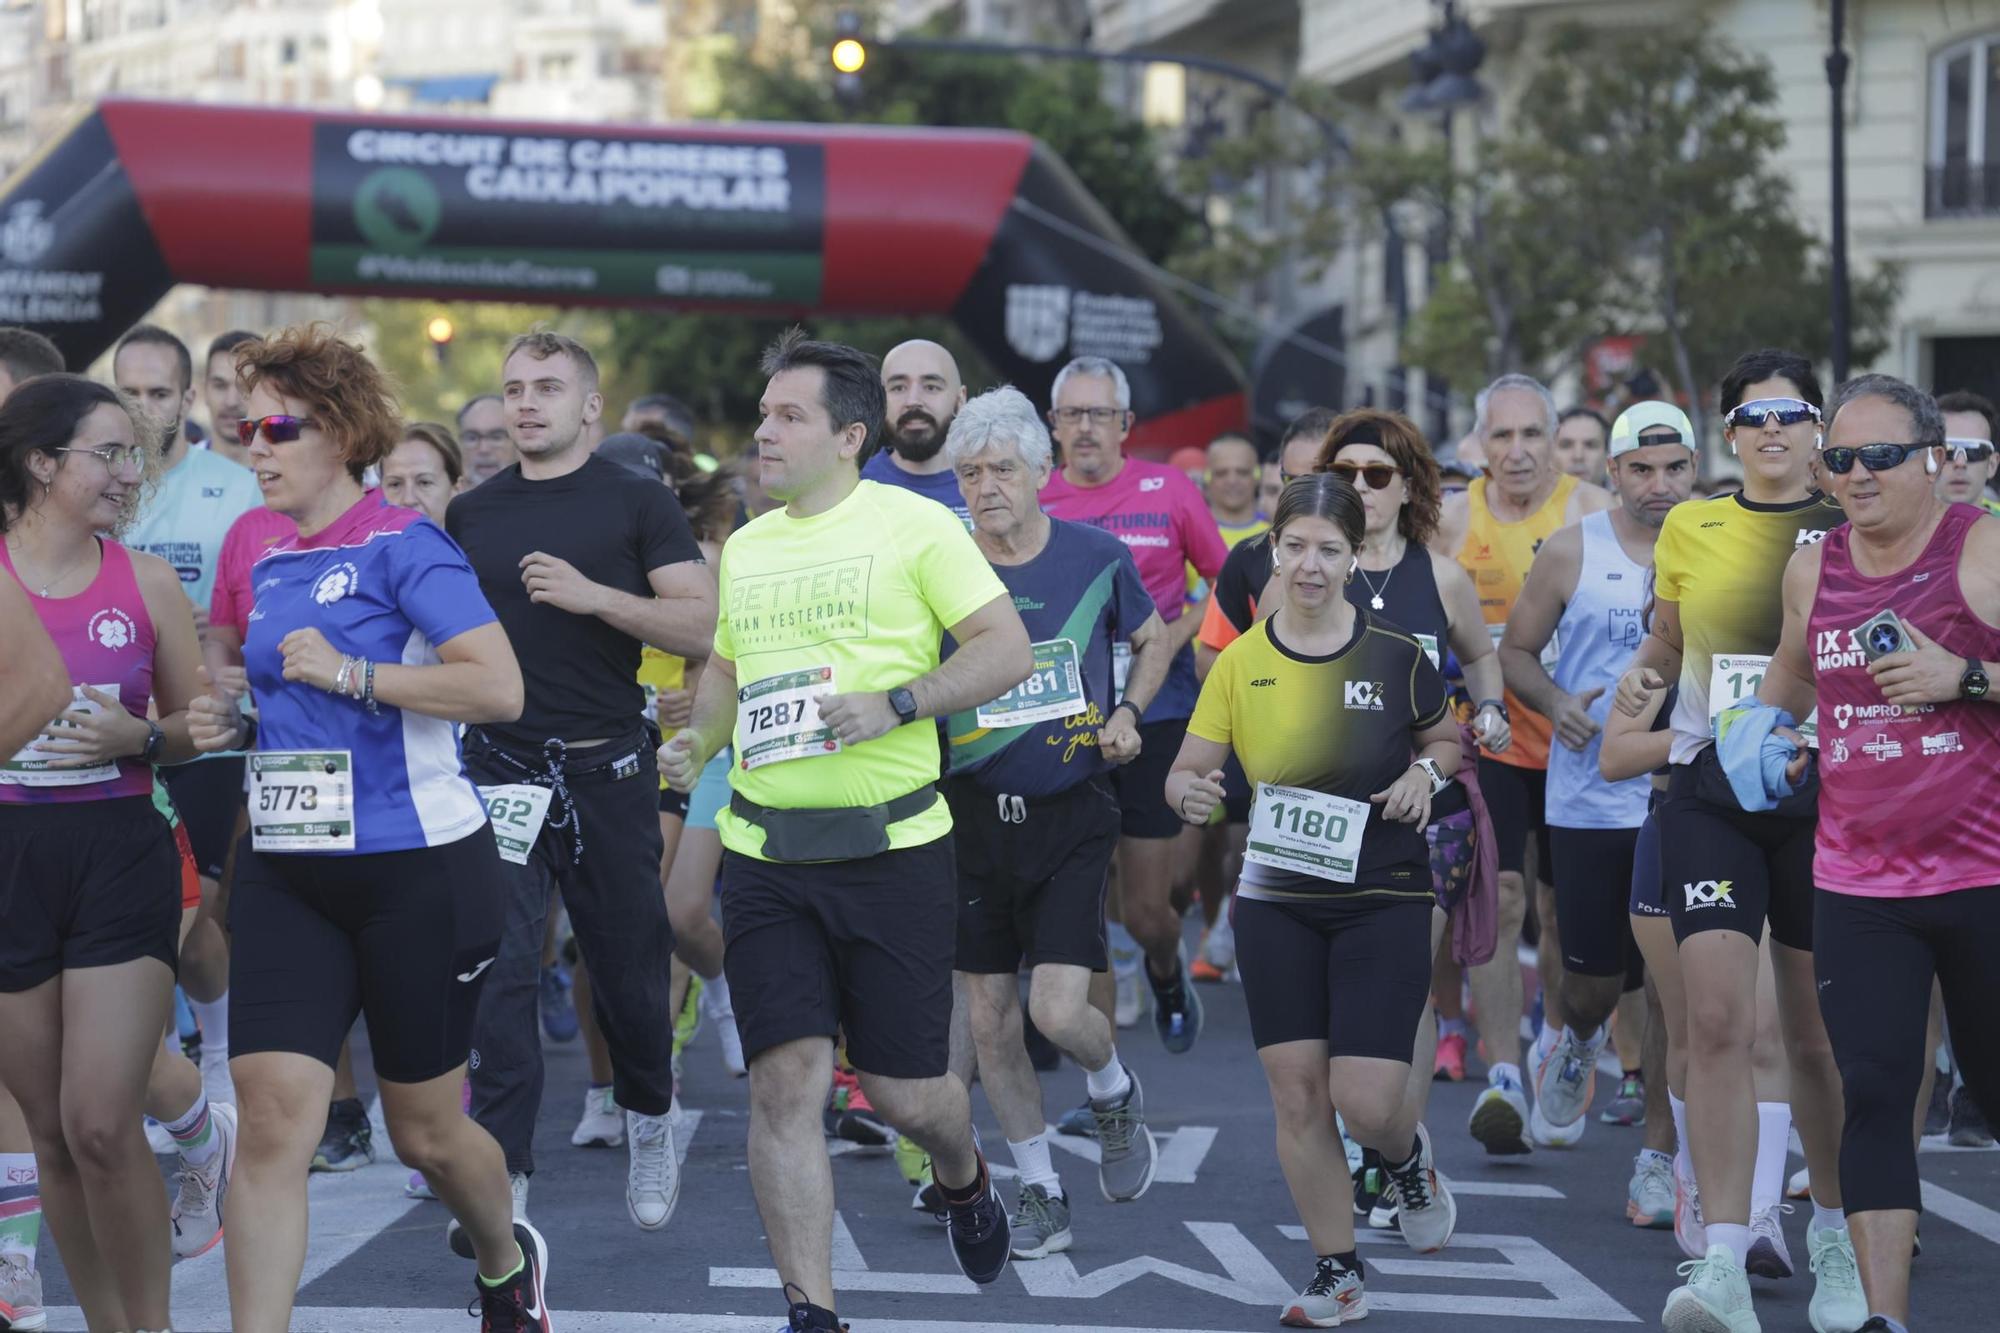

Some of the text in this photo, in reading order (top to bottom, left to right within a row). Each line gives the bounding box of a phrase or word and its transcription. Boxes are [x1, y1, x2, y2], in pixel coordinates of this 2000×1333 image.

[347, 130, 787, 176] CIRCUIT DE CARRERES
[465, 165, 792, 212] CAIXA POPULAR
[731, 567, 860, 614] BETTER
[770, 600, 855, 629] YESTERDAY
[1817, 630, 1841, 654] IX
[1817, 652, 1872, 671] MONT
[1251, 678, 1276, 687] 42K
[1727, 673, 1763, 699] 11
[748, 700, 807, 734] 7287
[260, 785, 317, 811] 5773
[1270, 802, 1349, 843] 1180
[1684, 880, 1735, 907] KX
[1686, 901, 1737, 912] RUNNING CLUB
